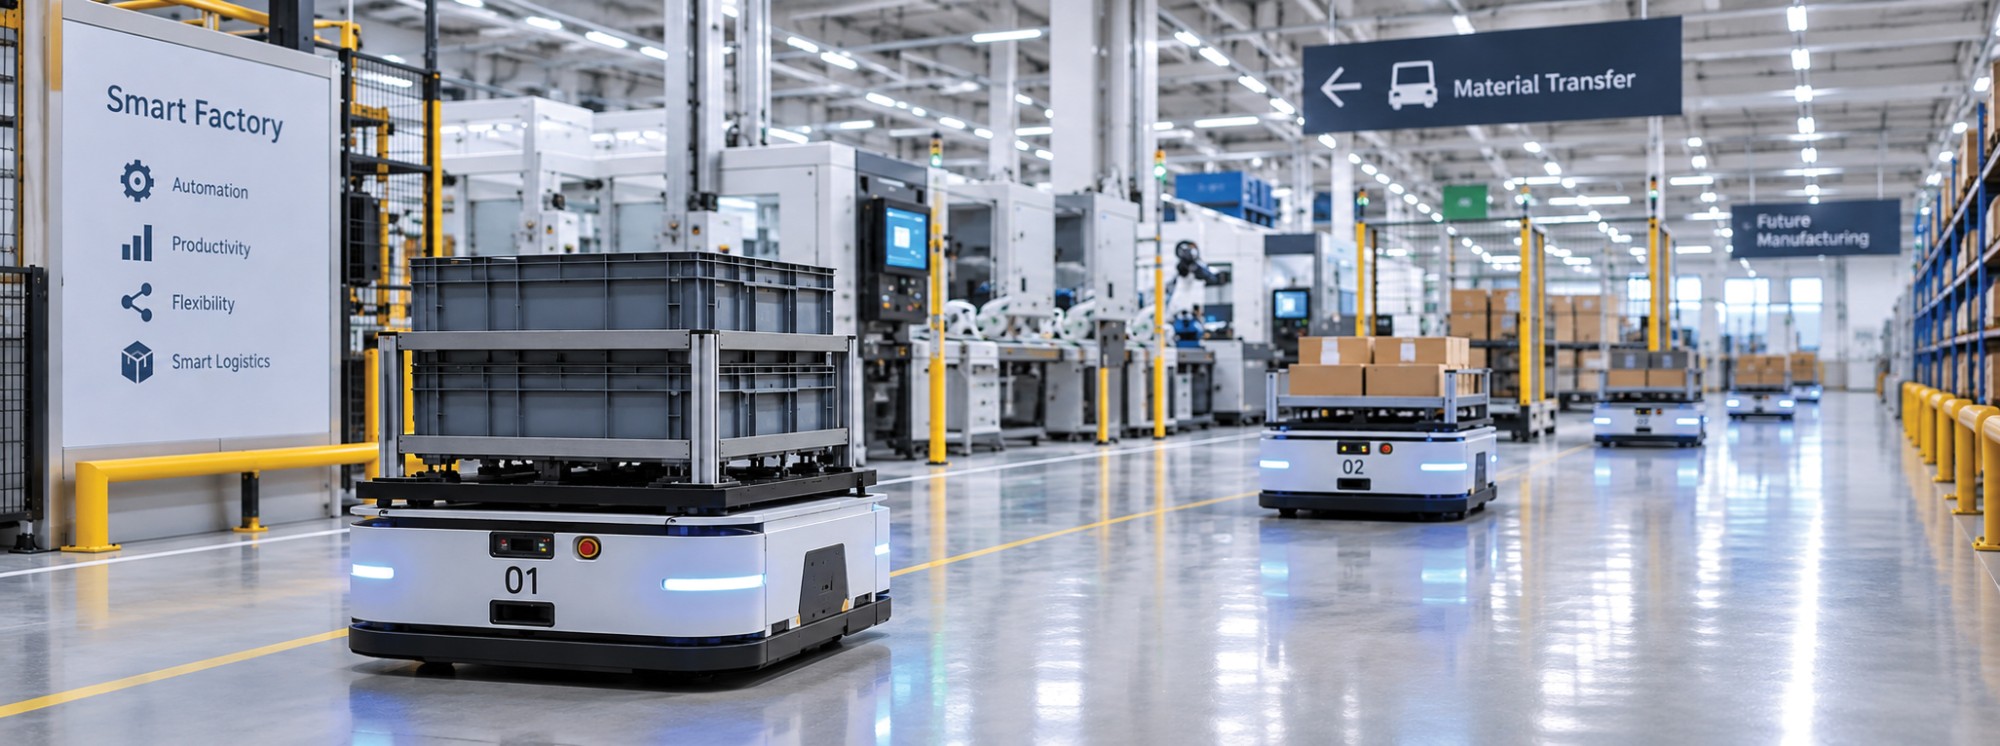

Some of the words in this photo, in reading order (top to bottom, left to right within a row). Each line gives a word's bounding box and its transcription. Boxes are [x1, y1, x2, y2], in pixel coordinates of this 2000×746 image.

[1454, 74, 1540, 98] Material
[1545, 69, 1636, 92] Transfer
[106, 84, 187, 124] Smart
[195, 99, 283, 144] Factory
[172, 177, 249, 200] Automation
[1756, 213, 1811, 229] Future
[172, 235, 251, 260] Productivity
[1756, 230, 1870, 249] Manufacturing
[172, 294, 236, 315] Flexibility
[172, 353, 213, 370] Smart
[215, 353, 271, 372] Logistics
[1342, 459, 1364, 475] 02
[505, 565, 537, 595] 01
